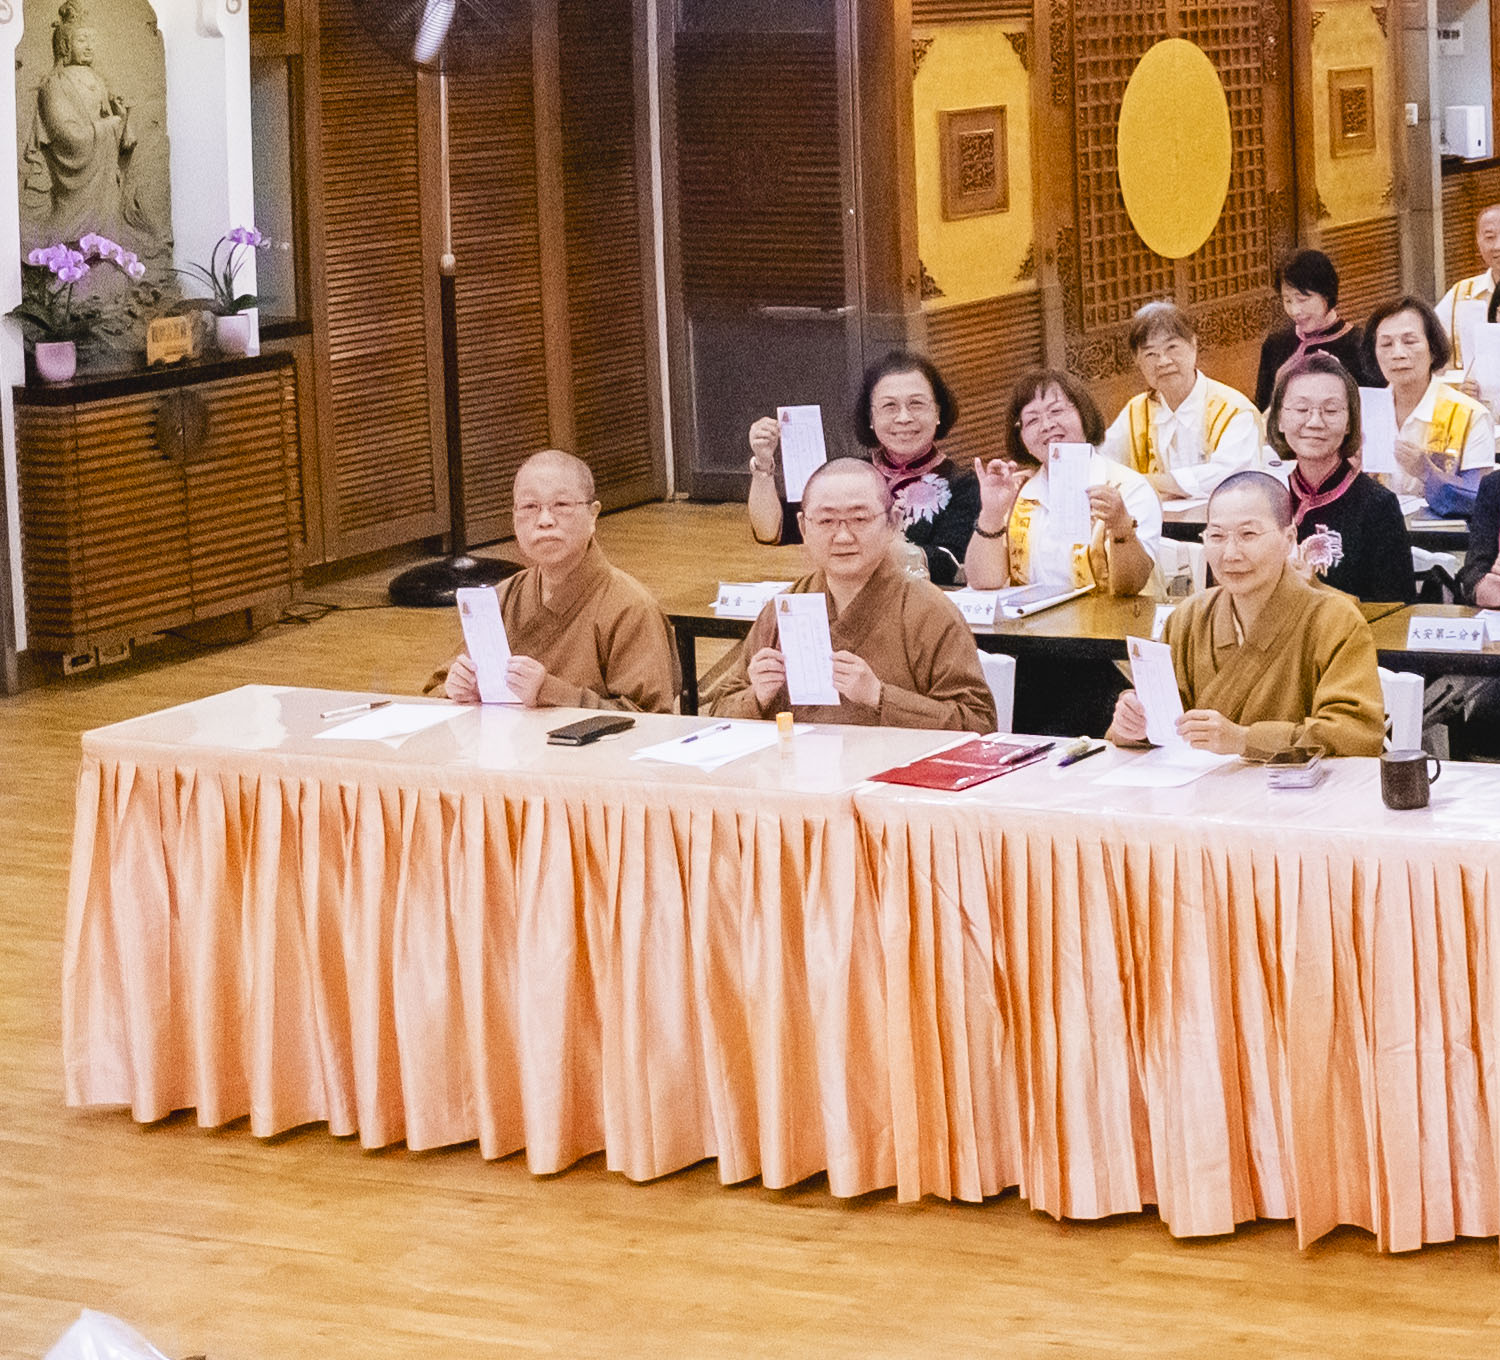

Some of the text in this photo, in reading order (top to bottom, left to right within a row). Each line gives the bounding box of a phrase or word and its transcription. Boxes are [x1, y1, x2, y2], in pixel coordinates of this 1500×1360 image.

[1411, 628, 1482, 642] 大安第二分會
